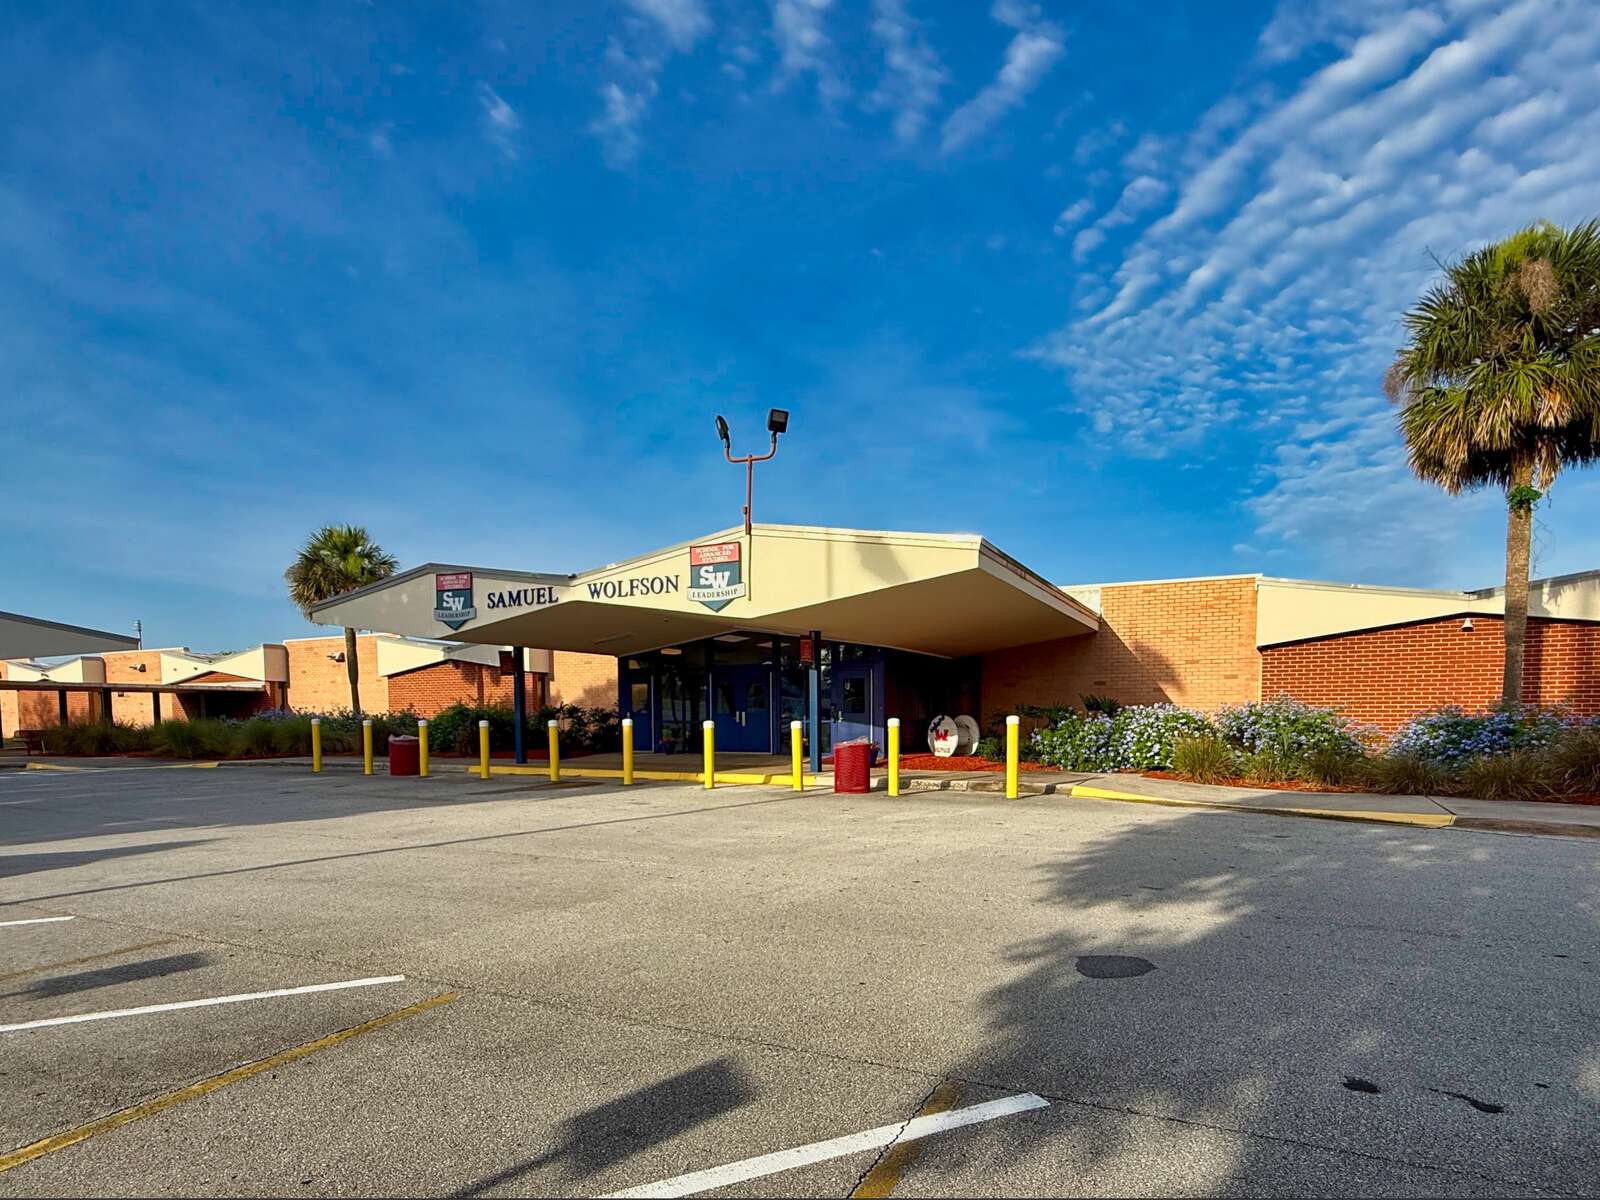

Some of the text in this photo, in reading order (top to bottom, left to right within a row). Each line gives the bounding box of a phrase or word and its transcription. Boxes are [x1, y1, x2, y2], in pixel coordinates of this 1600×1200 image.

[699, 565, 730, 589] SW
[442, 592, 465, 612] SW
[487, 575, 679, 609] SAMUEL WOLFSON
[692, 588, 738, 599] LEADERSHIP
